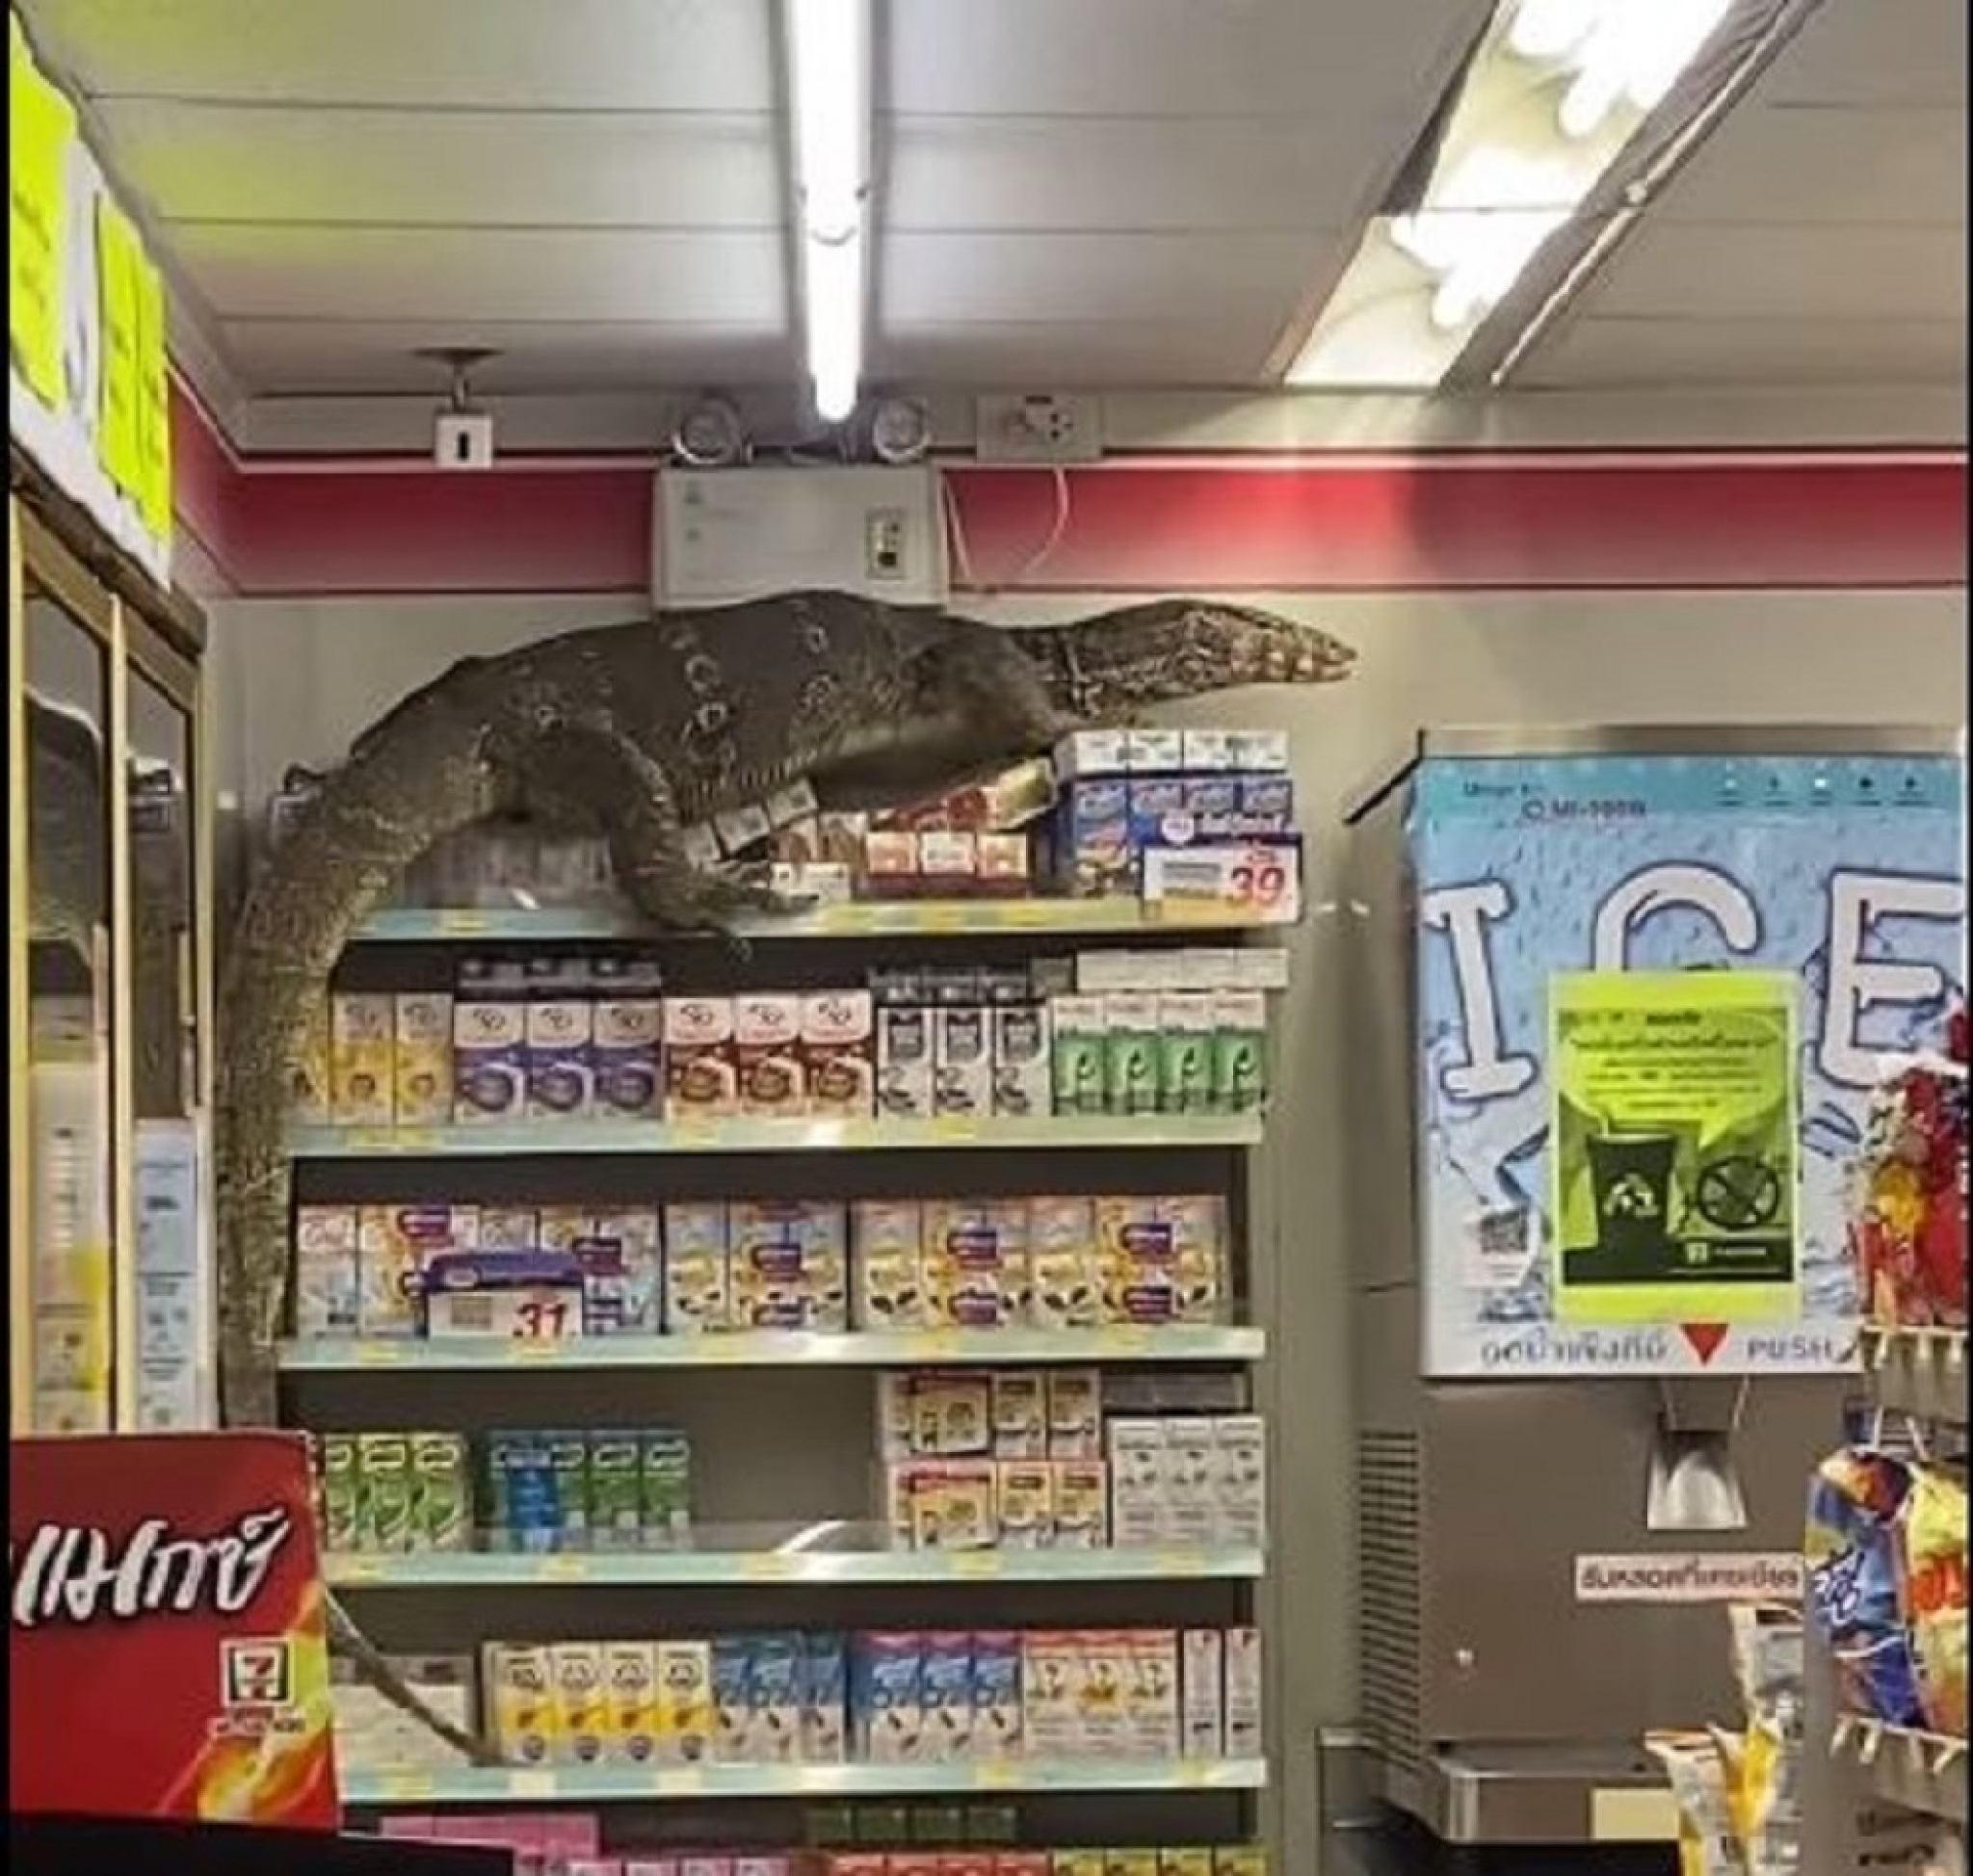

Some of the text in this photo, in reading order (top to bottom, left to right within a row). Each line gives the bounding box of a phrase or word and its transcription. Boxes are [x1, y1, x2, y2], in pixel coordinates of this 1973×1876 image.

[1226, 866, 1285, 907] 39
[513, 1303, 568, 1340] 31
[1747, 1334, 1833, 1362] PUSH
